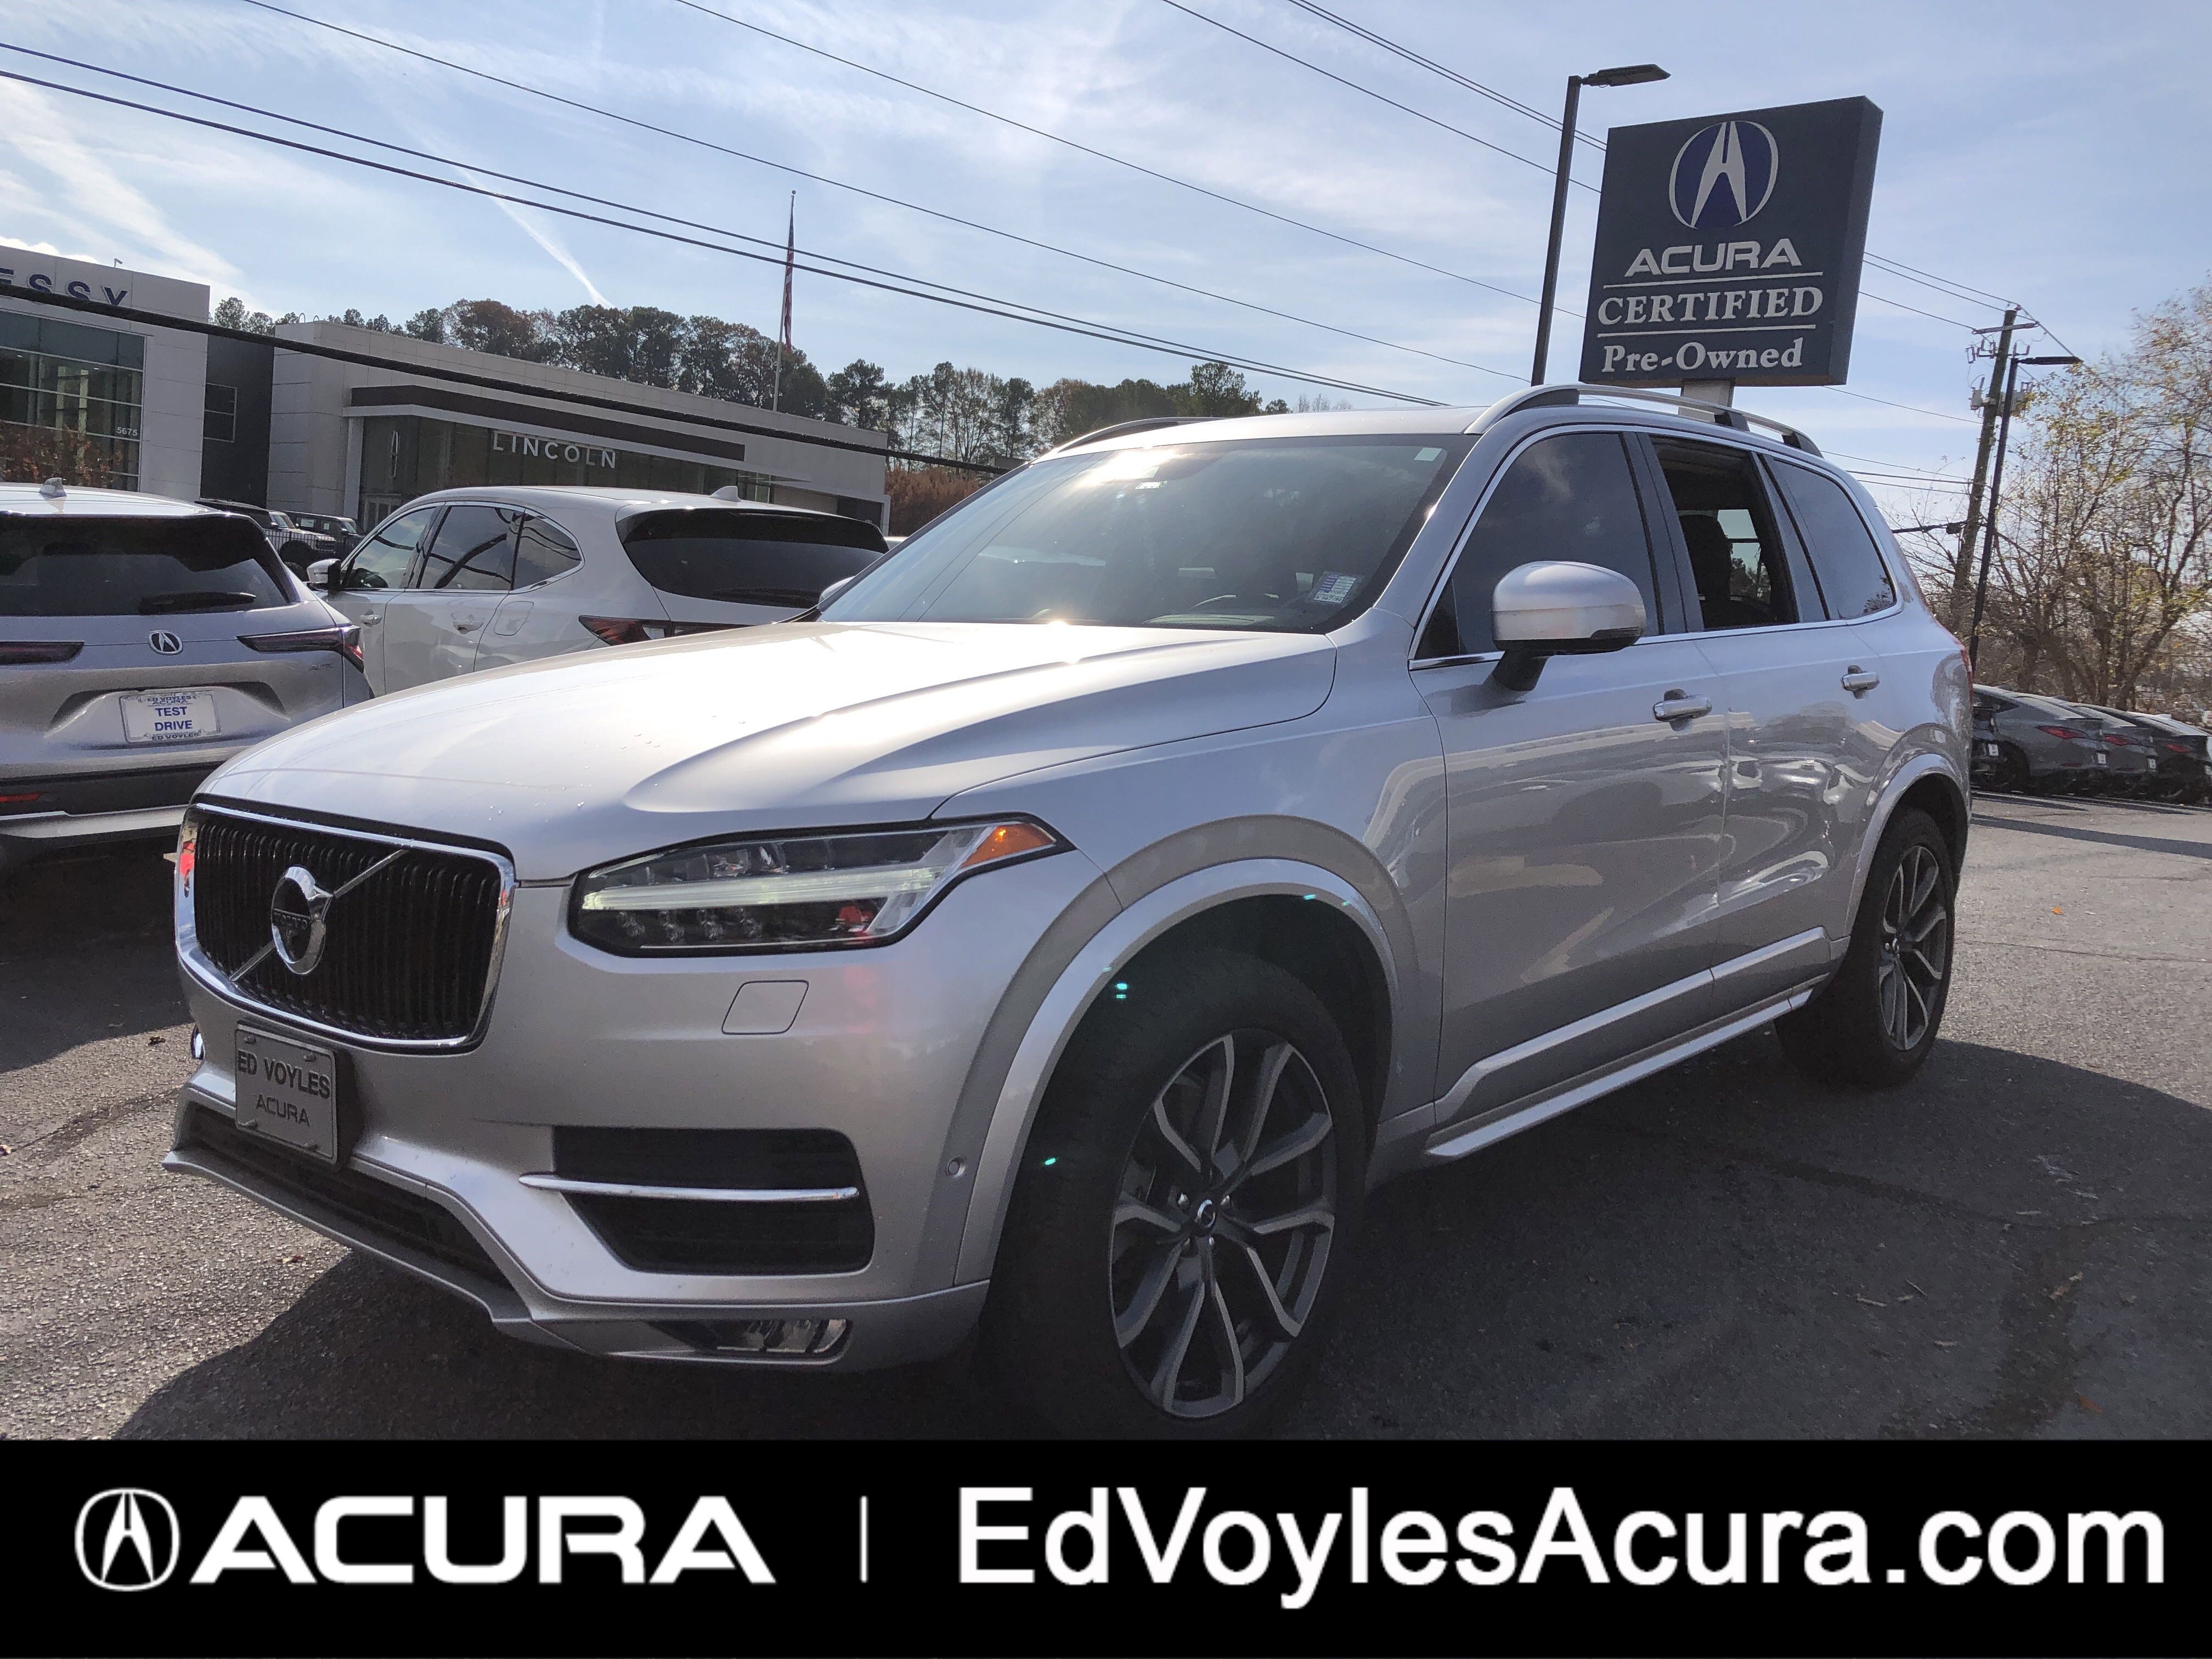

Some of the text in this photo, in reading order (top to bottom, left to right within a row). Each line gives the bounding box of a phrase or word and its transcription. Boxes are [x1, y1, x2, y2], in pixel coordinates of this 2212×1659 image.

[1624, 238, 1802, 276] ACURA
[1598, 286, 1823, 325] CERTIFIED
[1601, 337, 1804, 373] Pre-Owned
[116, 426, 138, 436] 5675
[493, 431, 616, 469] LINCOLN
[155, 706, 188, 716] TEST
[155, 720, 193, 731] DRIVE
[238, 1049, 330, 1099] ED VOYLES
[256, 1093, 311, 1127] ACURA
